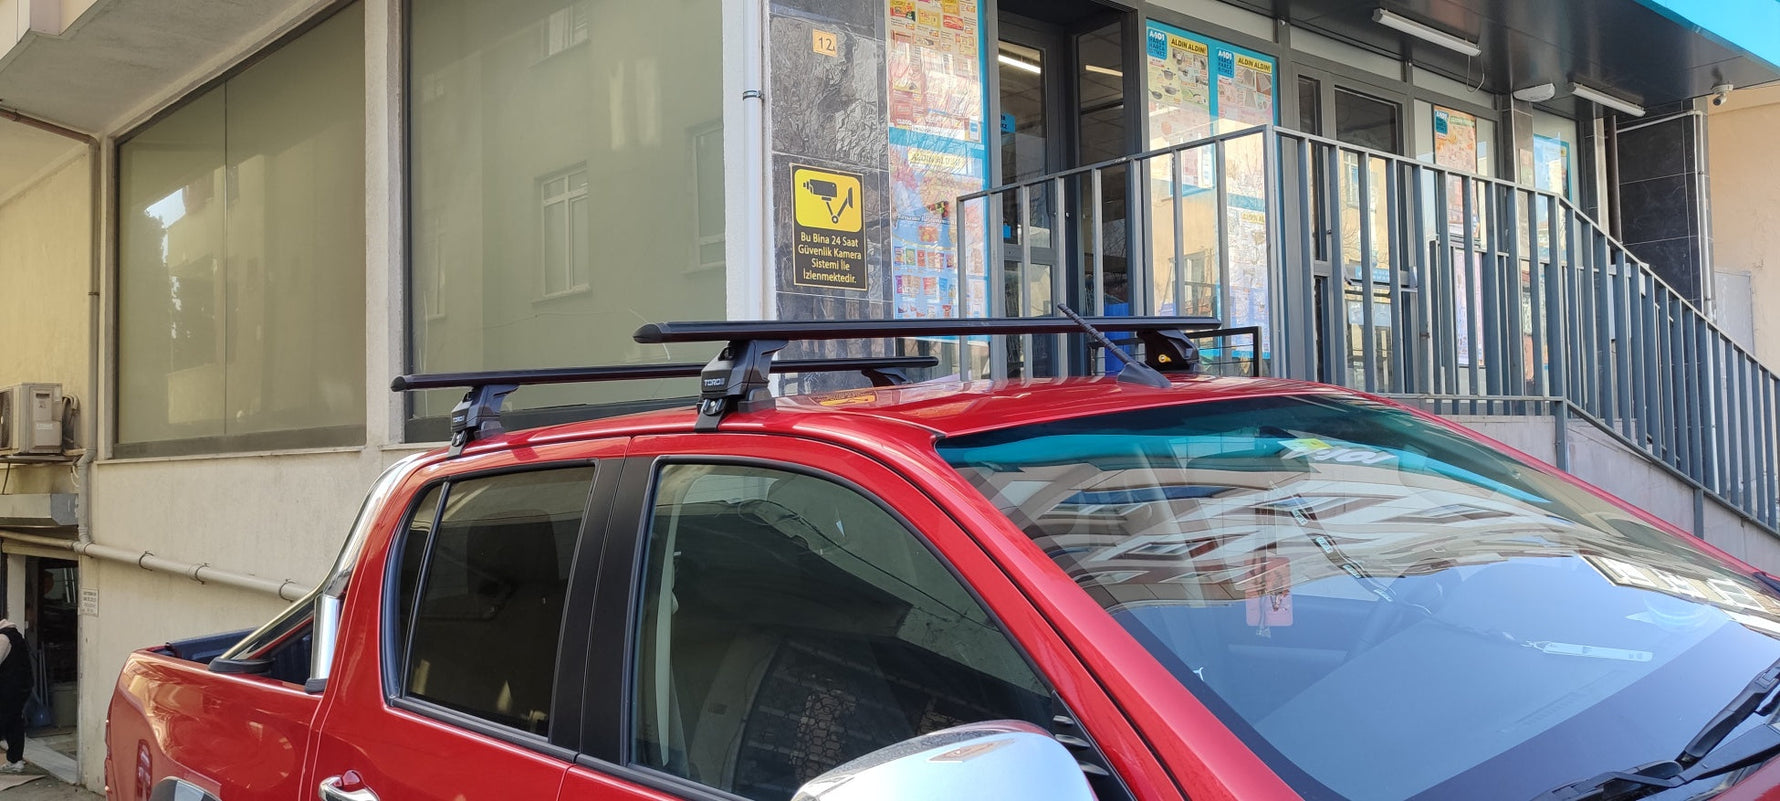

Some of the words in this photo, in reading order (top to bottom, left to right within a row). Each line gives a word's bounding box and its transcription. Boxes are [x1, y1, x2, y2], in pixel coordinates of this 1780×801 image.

[1171, 38, 1188, 49] ALDIN
[1238, 57, 1254, 67] ALDIN
[801, 231, 811, 242] Bu
[813, 233, 829, 244] Bina
[832, 236, 841, 246] 24
[843, 237, 858, 248] Saat
[798, 244, 832, 257] Güvenlik
[834, 248, 861, 260] Kamera
[811, 258, 839, 270] Sistemi
